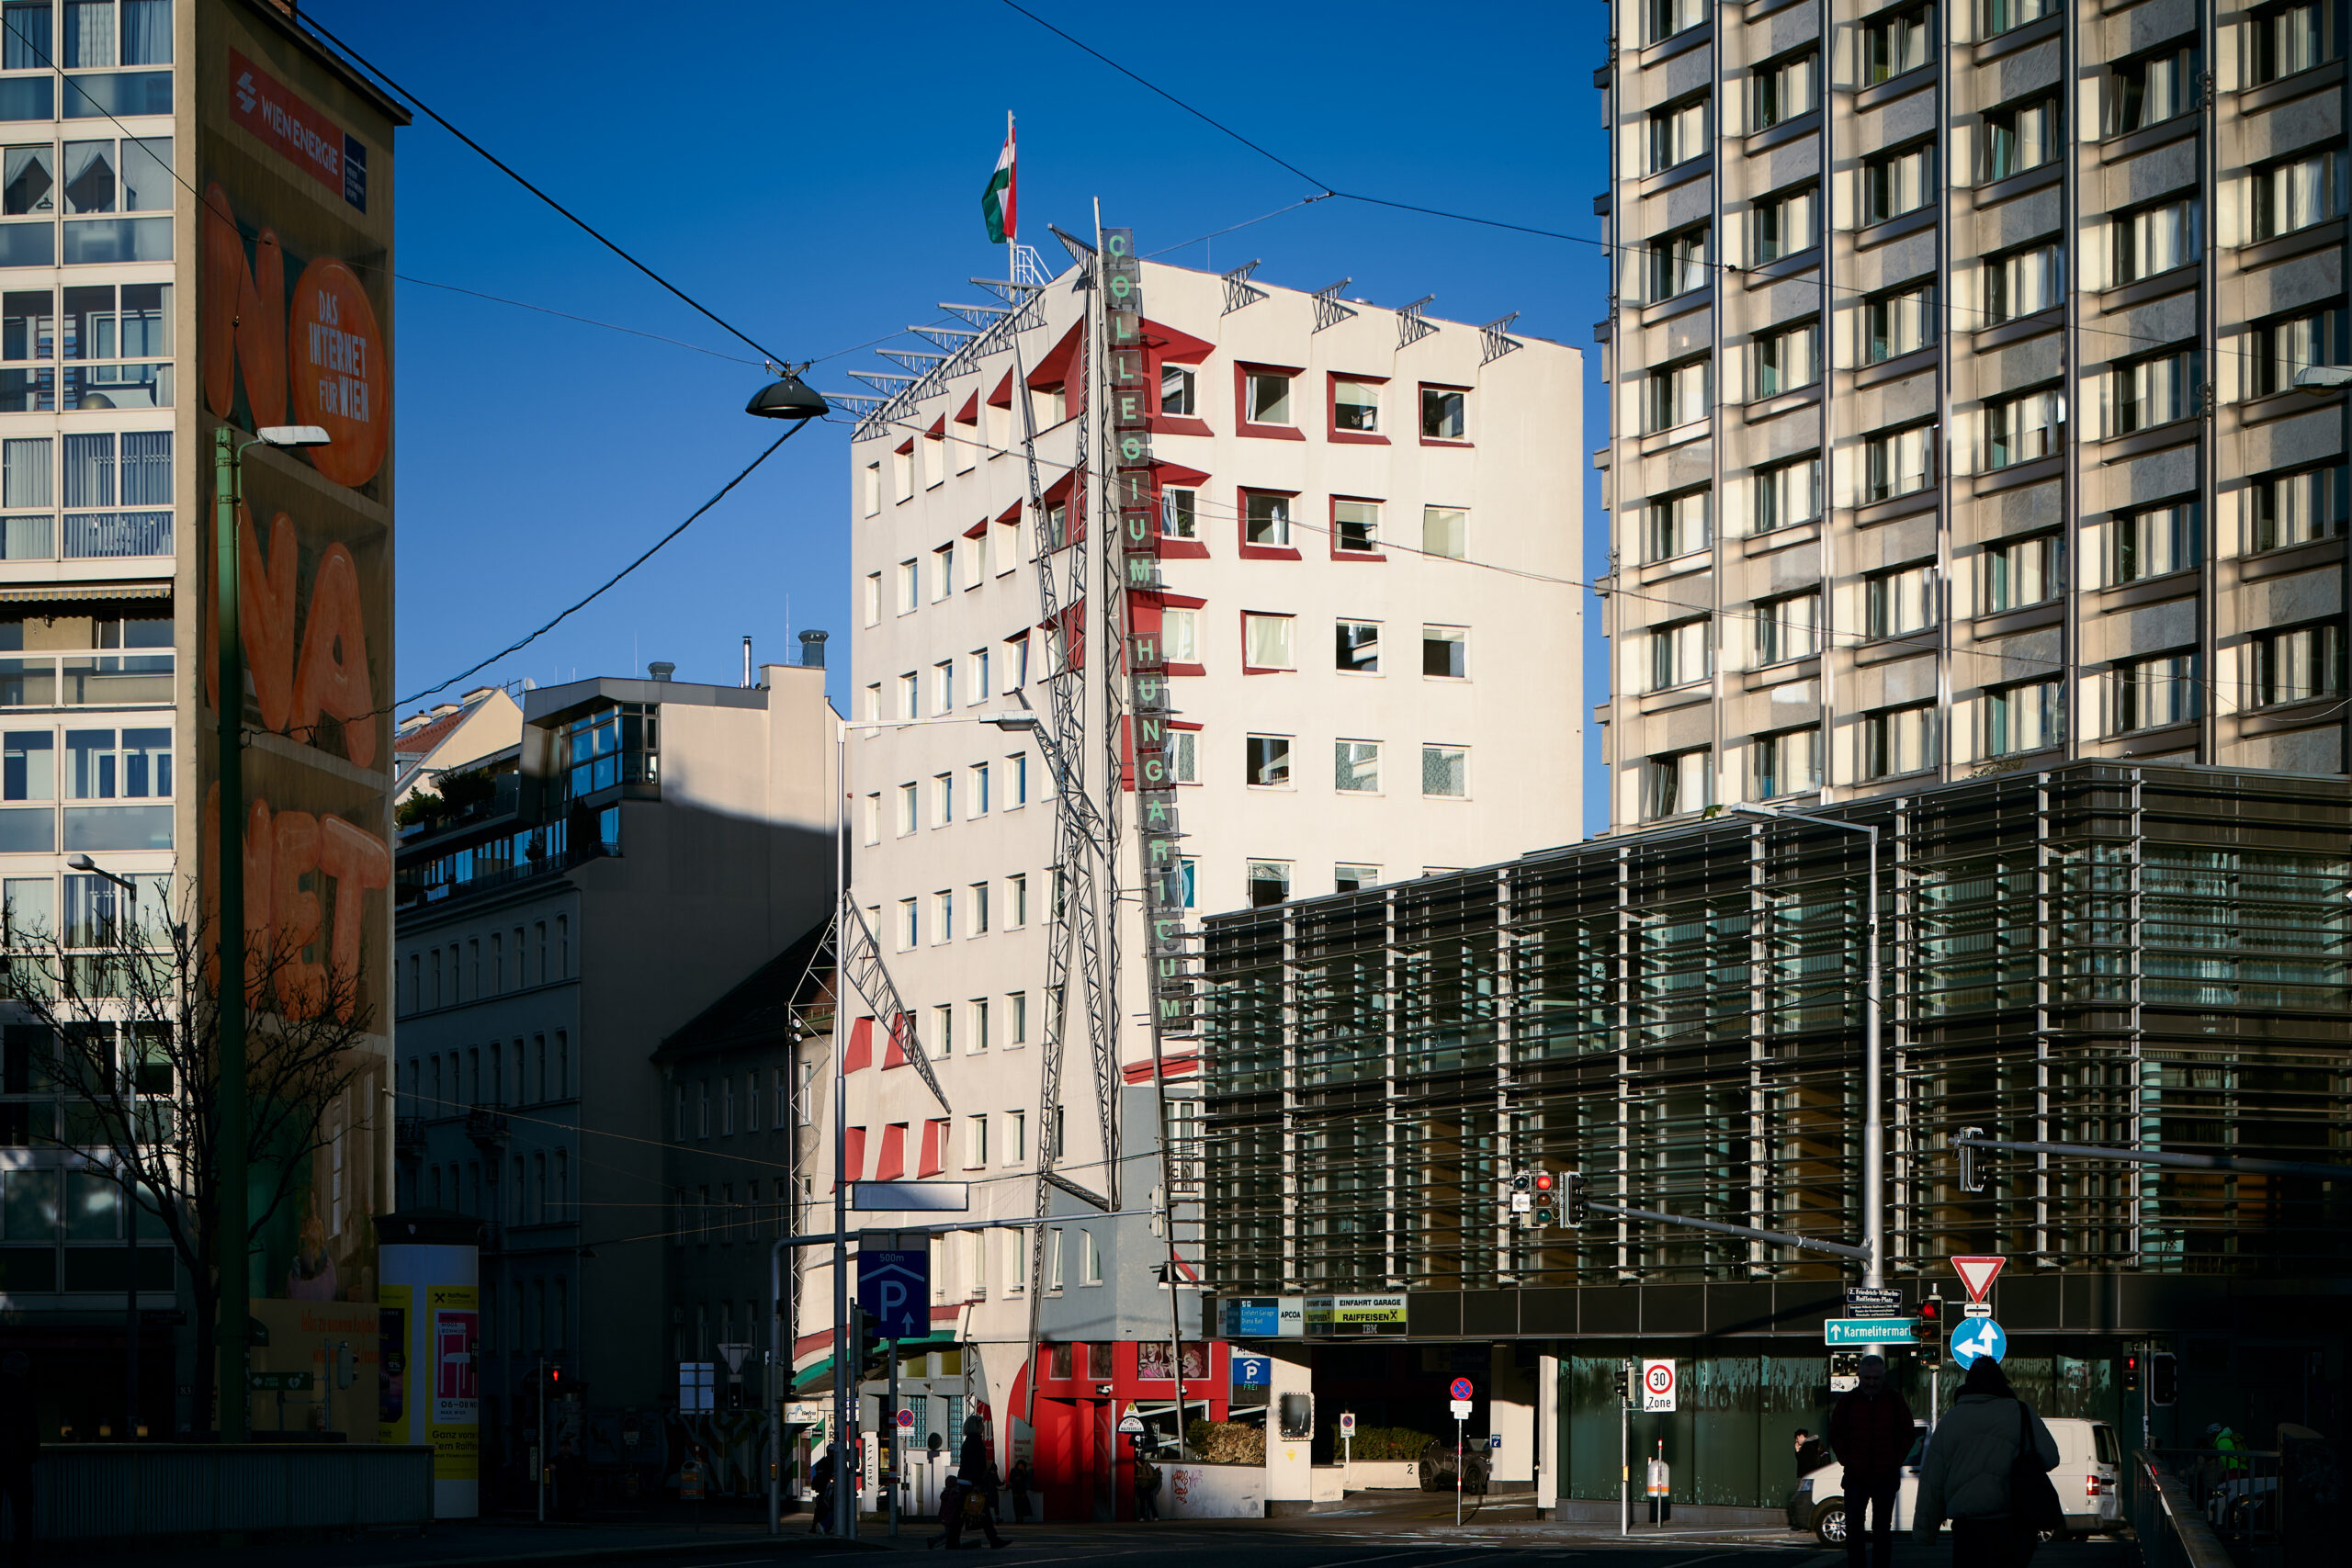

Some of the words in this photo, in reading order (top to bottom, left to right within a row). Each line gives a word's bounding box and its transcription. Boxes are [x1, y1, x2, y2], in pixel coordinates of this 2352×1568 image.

[261, 95, 291, 141] WIEN
[292, 118, 338, 176] ENERGIE
[319, 289, 338, 326] DAS
[309, 321, 367, 378] INTERNET
[319, 375, 338, 414] FÜR
[338, 375, 369, 423] WIEN
[1108, 234, 1151, 582] COLLEGIUM
[1136, 637, 1181, 1021] HUNGARICUM
[879, 1253, 905, 1263] 500m
[1259, 1309, 1274, 1317] Garage
[1342, 1314, 1389, 1322] RAIFFEISEN
[1363, 1324, 1378, 1334] IBM
[1653, 1372, 1666, 1386] 30
[1648, 1396, 1671, 1408] Zone
[432, 1430, 457, 1438] Ganz
[1407, 1463, 1413, 1474] 2
